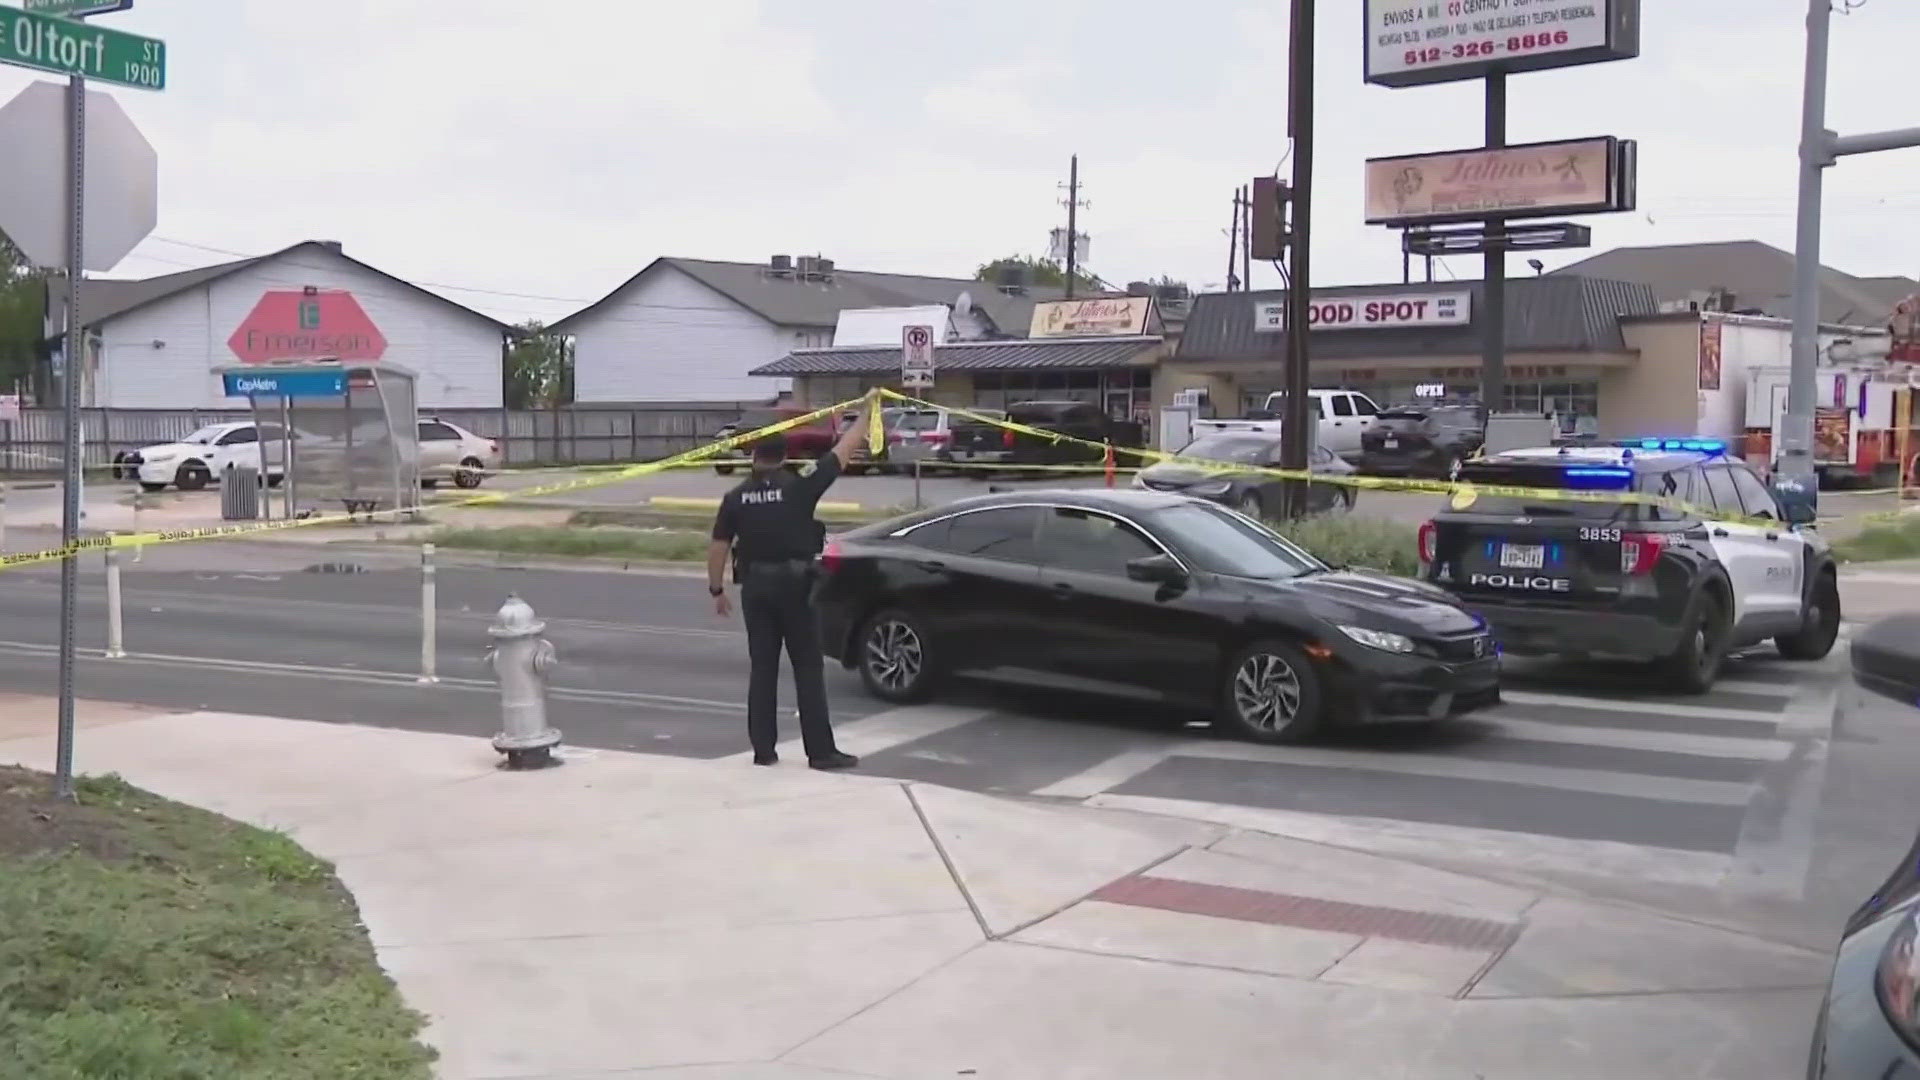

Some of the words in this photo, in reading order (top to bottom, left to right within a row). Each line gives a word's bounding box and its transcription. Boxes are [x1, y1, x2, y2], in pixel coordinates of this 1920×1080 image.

[1383, 9, 1414, 26] ENVIOS
[1418, 7, 1424, 20] A
[14, 16, 105, 72] Oltorf
[143, 41, 161, 62] ST
[1404, 30, 1568, 65] 512-326-8886
[125, 61, 160, 87] 1900
[1308, 303, 1354, 324] OOD
[1365, 300, 1429, 322] SPOT
[246, 329, 371, 354] Emerson
[236, 378, 278, 392] CapMetro
[1415, 383, 1445, 397] OPEN
[741, 488, 783, 505] POLICE
[1579, 527, 1621, 542] 3853
[1471, 573, 1570, 592] POLICE
